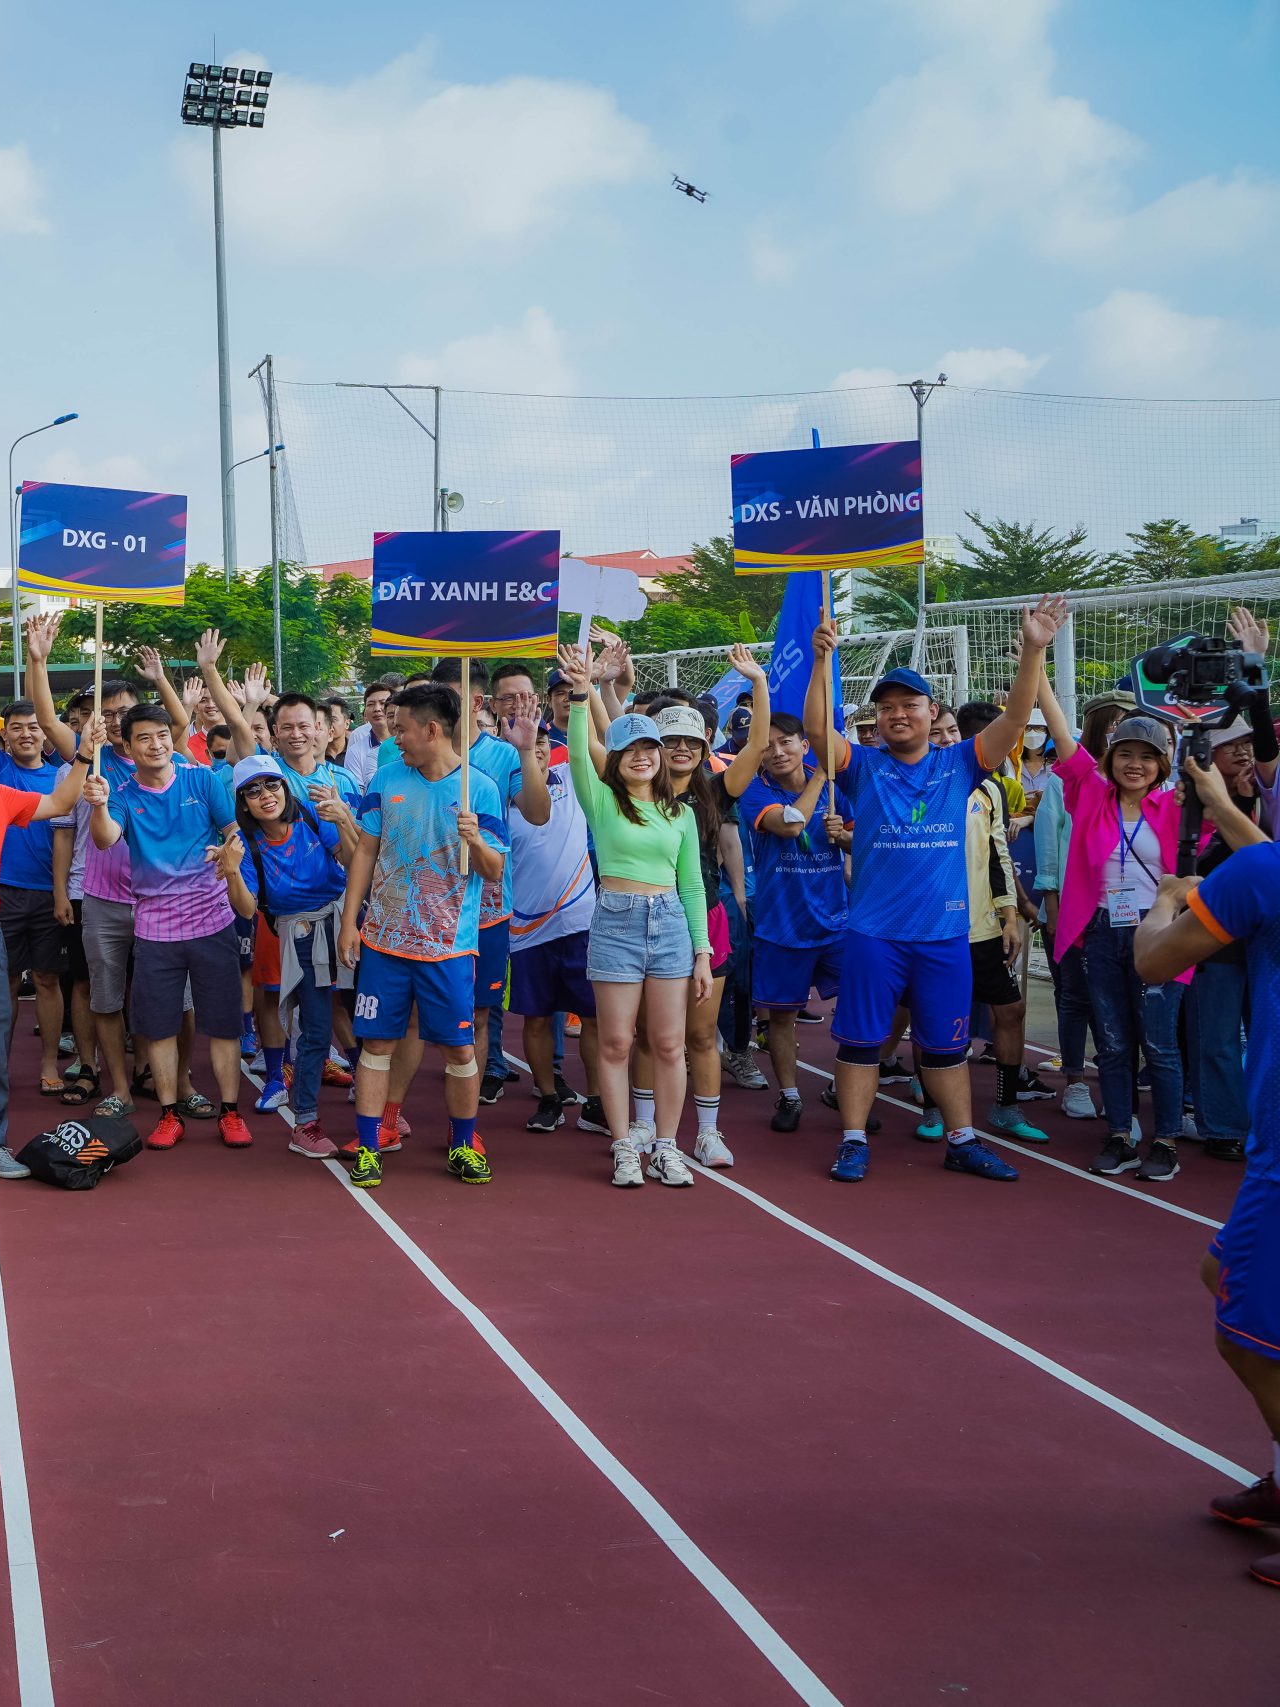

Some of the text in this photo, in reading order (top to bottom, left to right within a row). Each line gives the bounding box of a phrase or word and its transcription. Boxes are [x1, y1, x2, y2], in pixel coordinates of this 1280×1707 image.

[740, 501, 781, 523] DXS
[795, 495, 839, 519] VĂN
[844, 490, 921, 515] PHÒNG
[62, 528, 106, 550] DXG
[123, 534, 147, 553] 01
[377, 575, 552, 602] ĐẤT XANH E&C
[880, 824, 901, 834] GEM
[922, 822, 955, 834] WORLD
[59, 1140, 76, 1155] YOU
